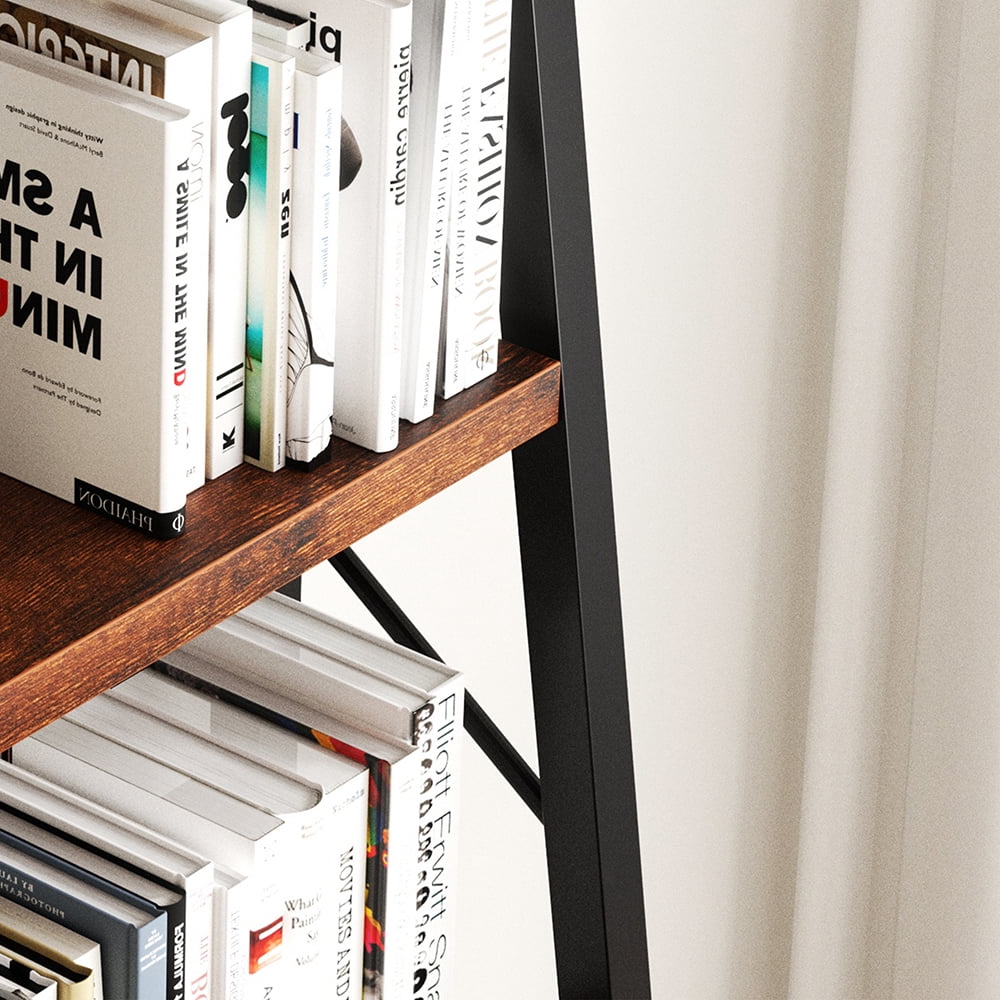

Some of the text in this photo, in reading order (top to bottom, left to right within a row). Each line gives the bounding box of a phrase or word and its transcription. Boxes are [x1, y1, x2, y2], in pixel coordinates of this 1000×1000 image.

[434, 692, 456, 798] Elliott
[430, 811, 451, 920] Erwitt
[335, 846, 354, 997] MOVIES AND
